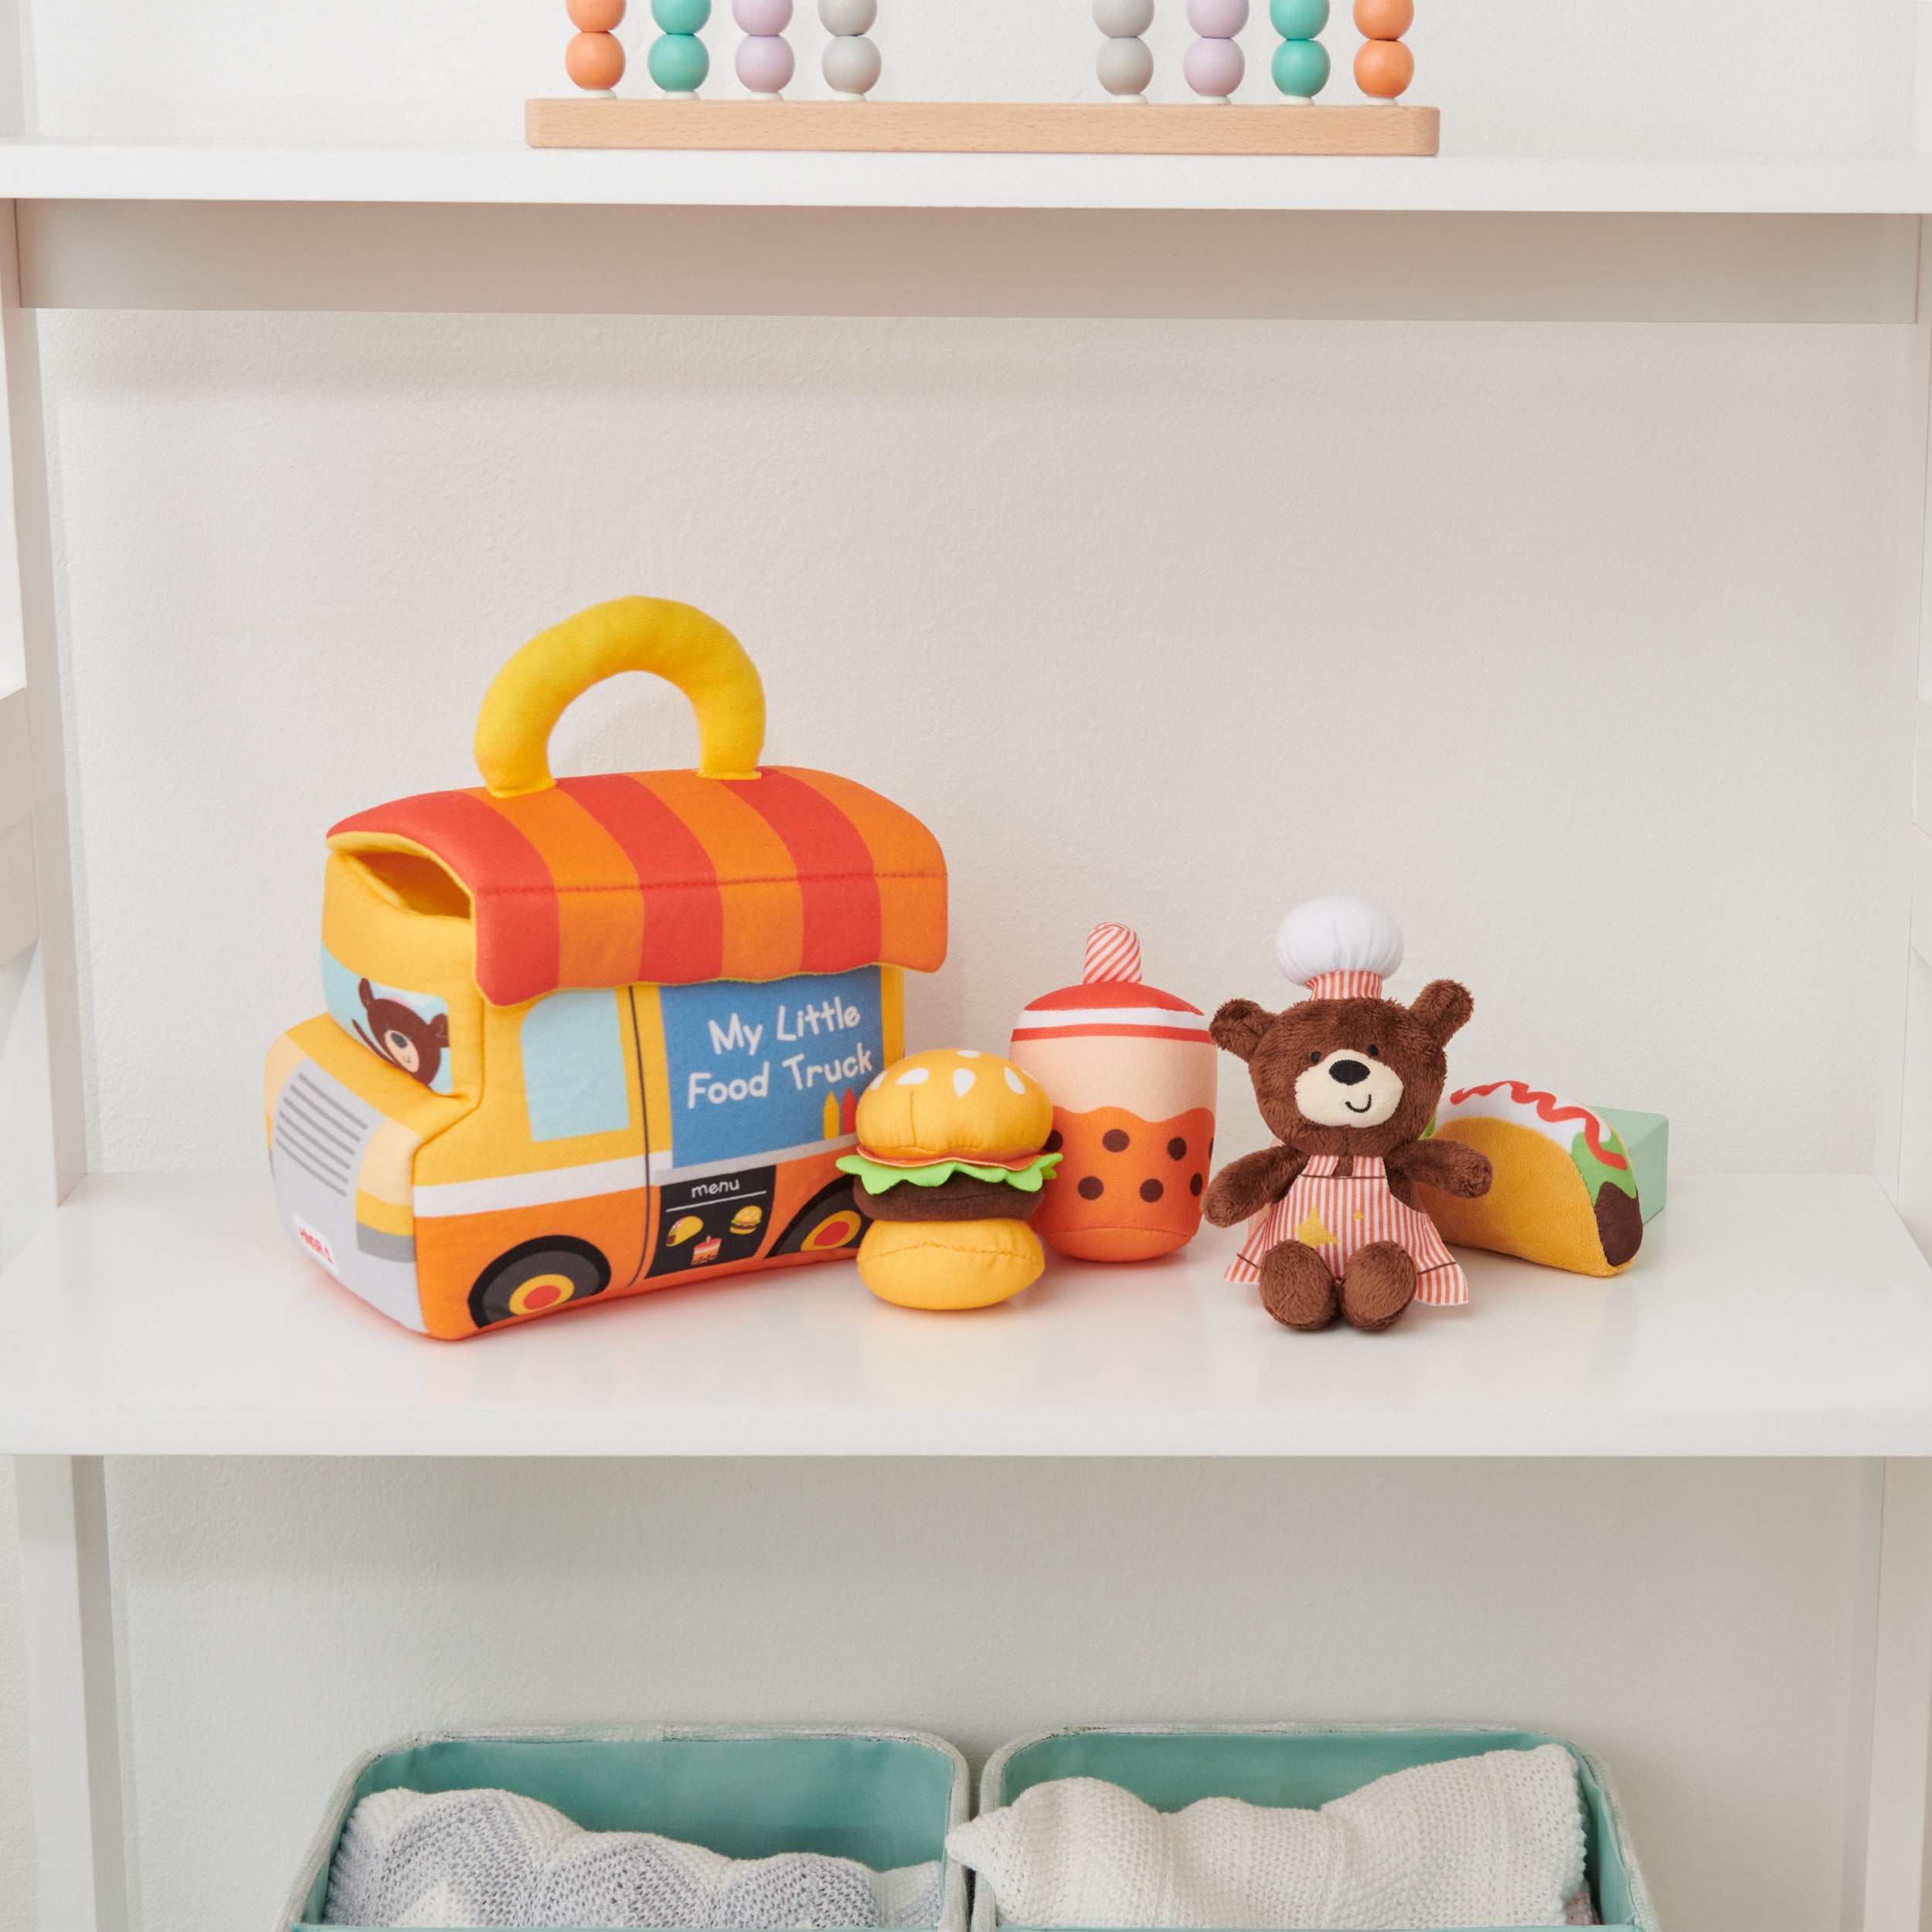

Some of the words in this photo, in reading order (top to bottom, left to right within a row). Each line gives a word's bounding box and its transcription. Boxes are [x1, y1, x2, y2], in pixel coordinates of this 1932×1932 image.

[708, 1012, 764, 1056] My
[776, 995, 861, 1042] Little
[687, 1060, 770, 1110] Food
[781, 1042, 873, 1091] Truck
[691, 1179, 740, 1199] menu
